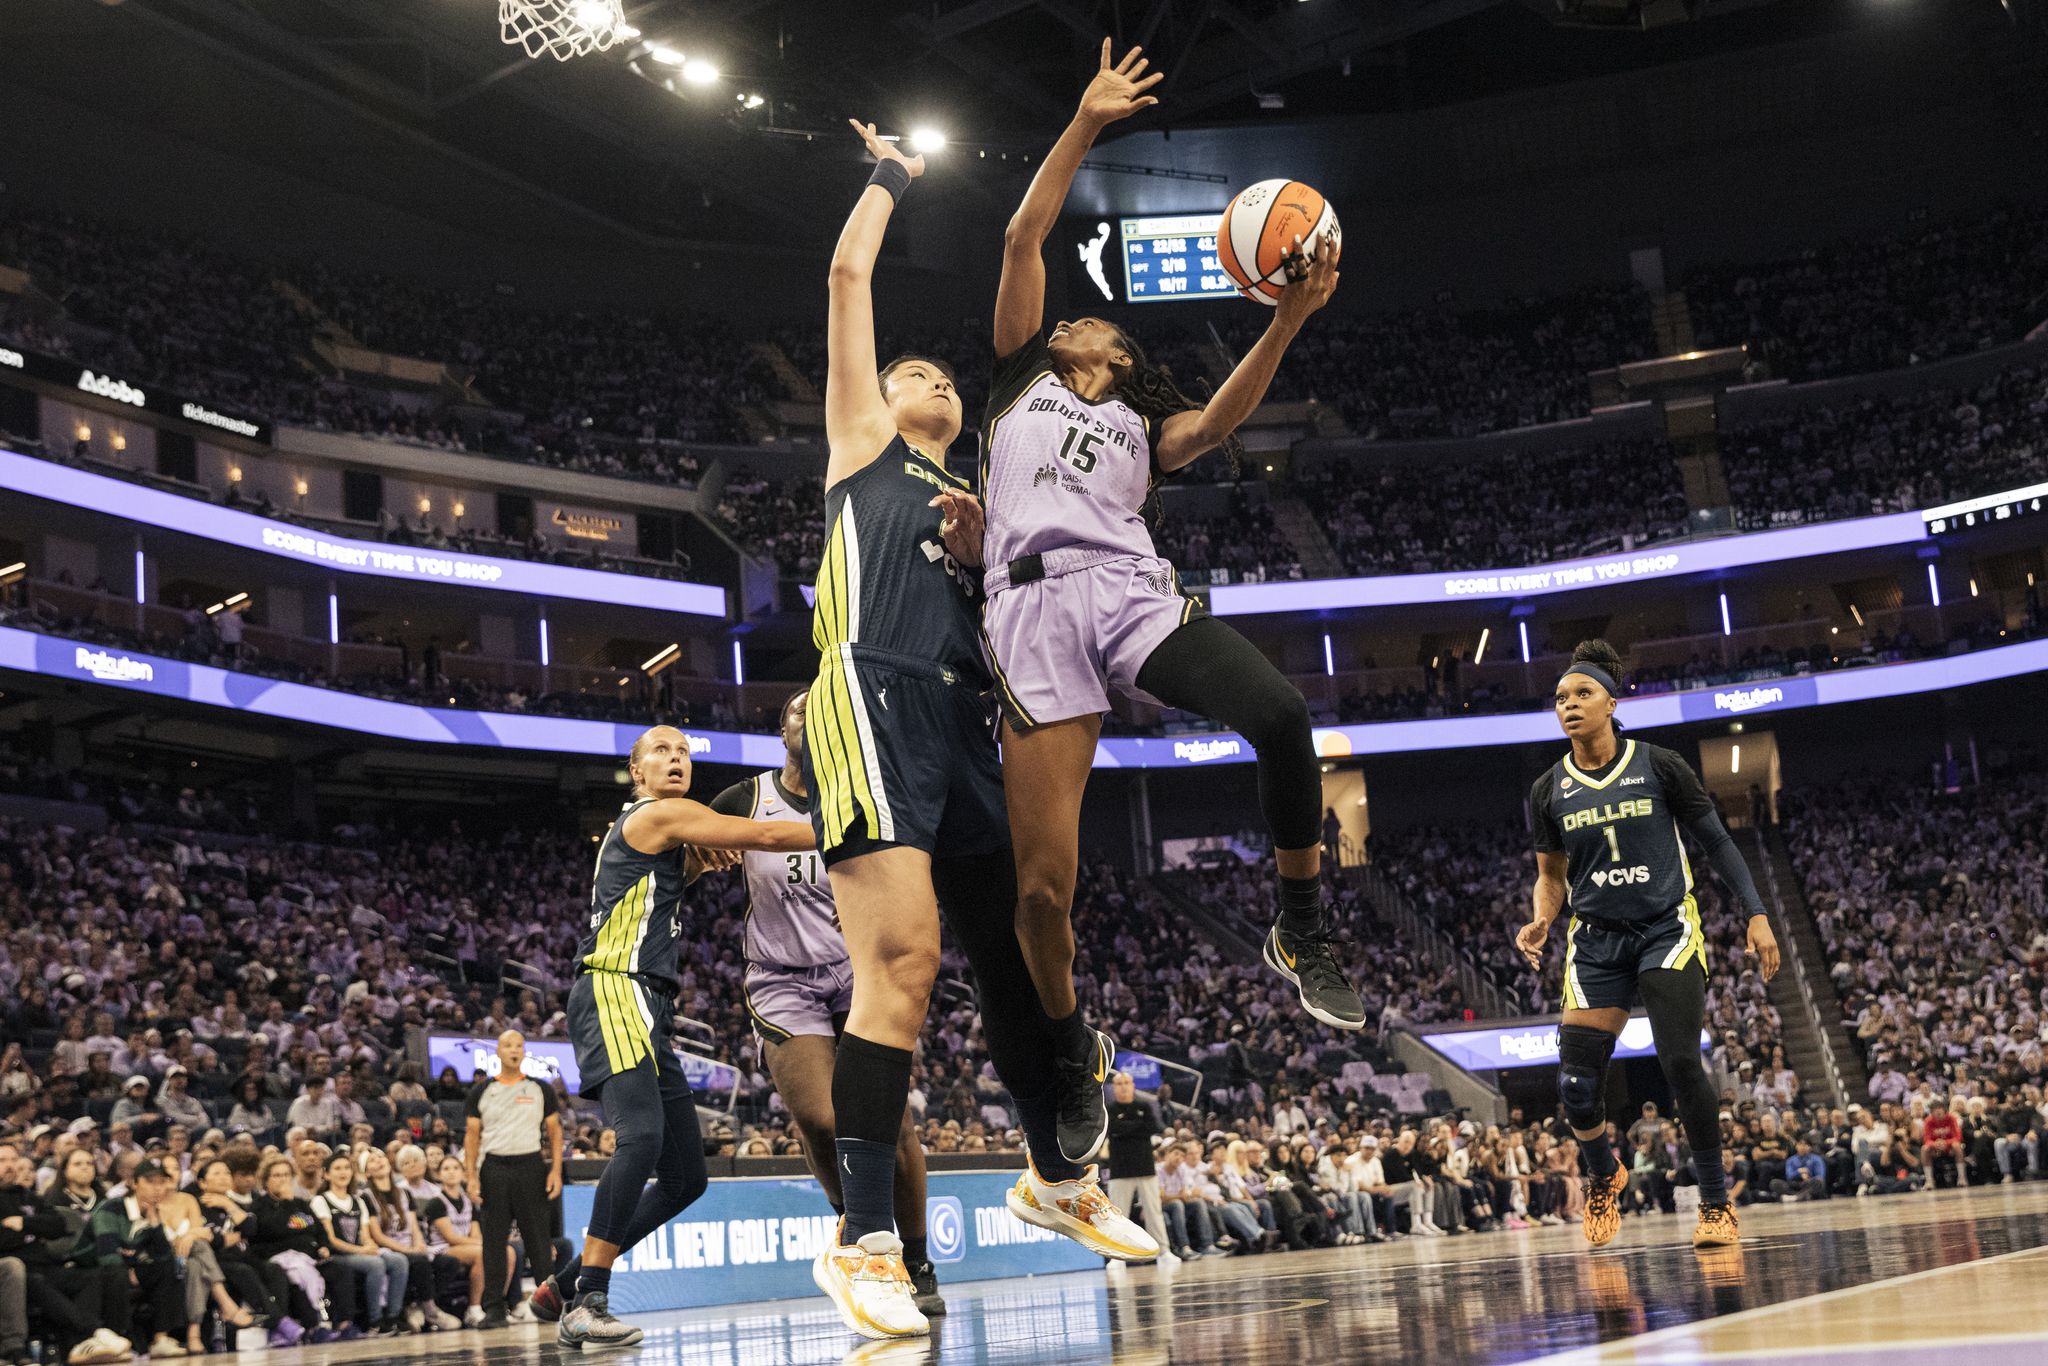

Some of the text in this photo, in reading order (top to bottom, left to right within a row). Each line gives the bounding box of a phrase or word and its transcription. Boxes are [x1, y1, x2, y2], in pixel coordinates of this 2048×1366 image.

[78, 370, 145, 407] Adobe
[182, 402, 259, 437] ticketmaster
[1027, 397, 1090, 425] GOLDEN
[1059, 425, 1106, 475] 15
[262, 527, 502, 582] SCORE EVERY TIME YOU SHOP
[1445, 554, 1679, 595] SCORE EVERY TIME YOU SHOP
[75, 646, 154, 682] Rakuten
[1714, 687, 1783, 712] Rakuten
[1174, 739, 1240, 762] Rakuten
[1619, 776, 1645, 787] Albert
[1562, 798, 1653, 833] DALLAS
[1602, 825, 1621, 863] 1
[785, 853, 818, 886] 31
[1608, 865, 1651, 886] CVS
[673, 1221, 725, 1269] NEW
[727, 1217, 780, 1266] GOLF
